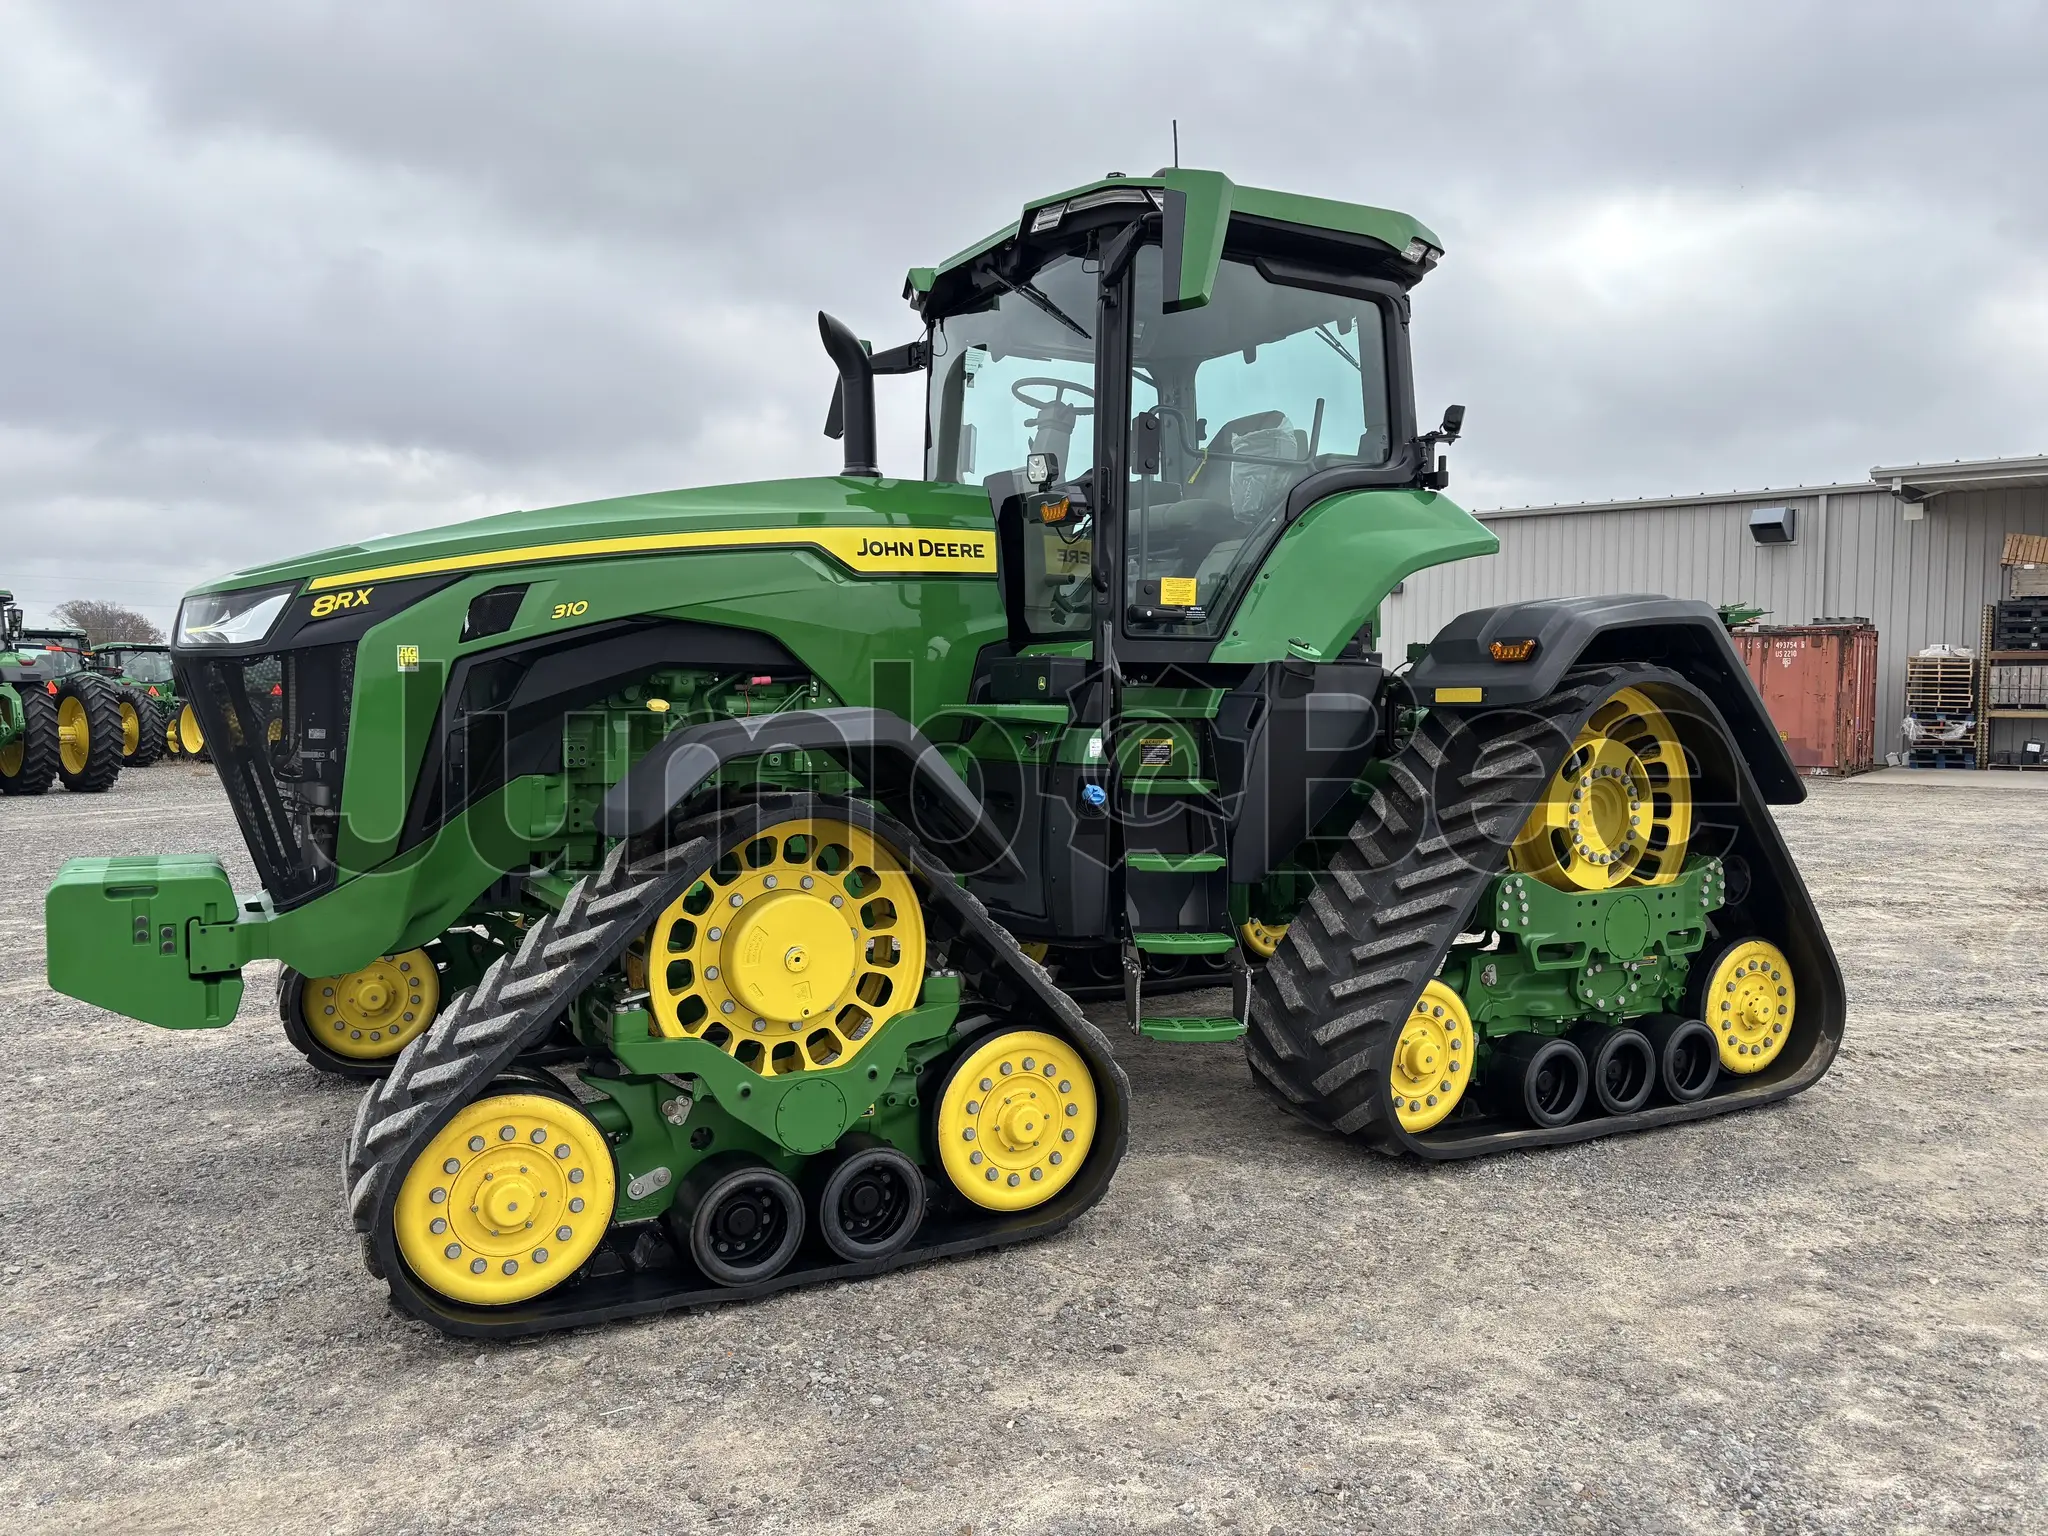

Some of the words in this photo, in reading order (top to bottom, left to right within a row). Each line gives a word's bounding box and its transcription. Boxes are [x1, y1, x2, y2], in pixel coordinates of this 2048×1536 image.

[857, 538, 913, 557] JOHN
[918, 539, 985, 558] DEERE
[310, 588, 374, 617] 8RX
[551, 600, 589, 620] 310
[400, 647, 417, 657] AG
